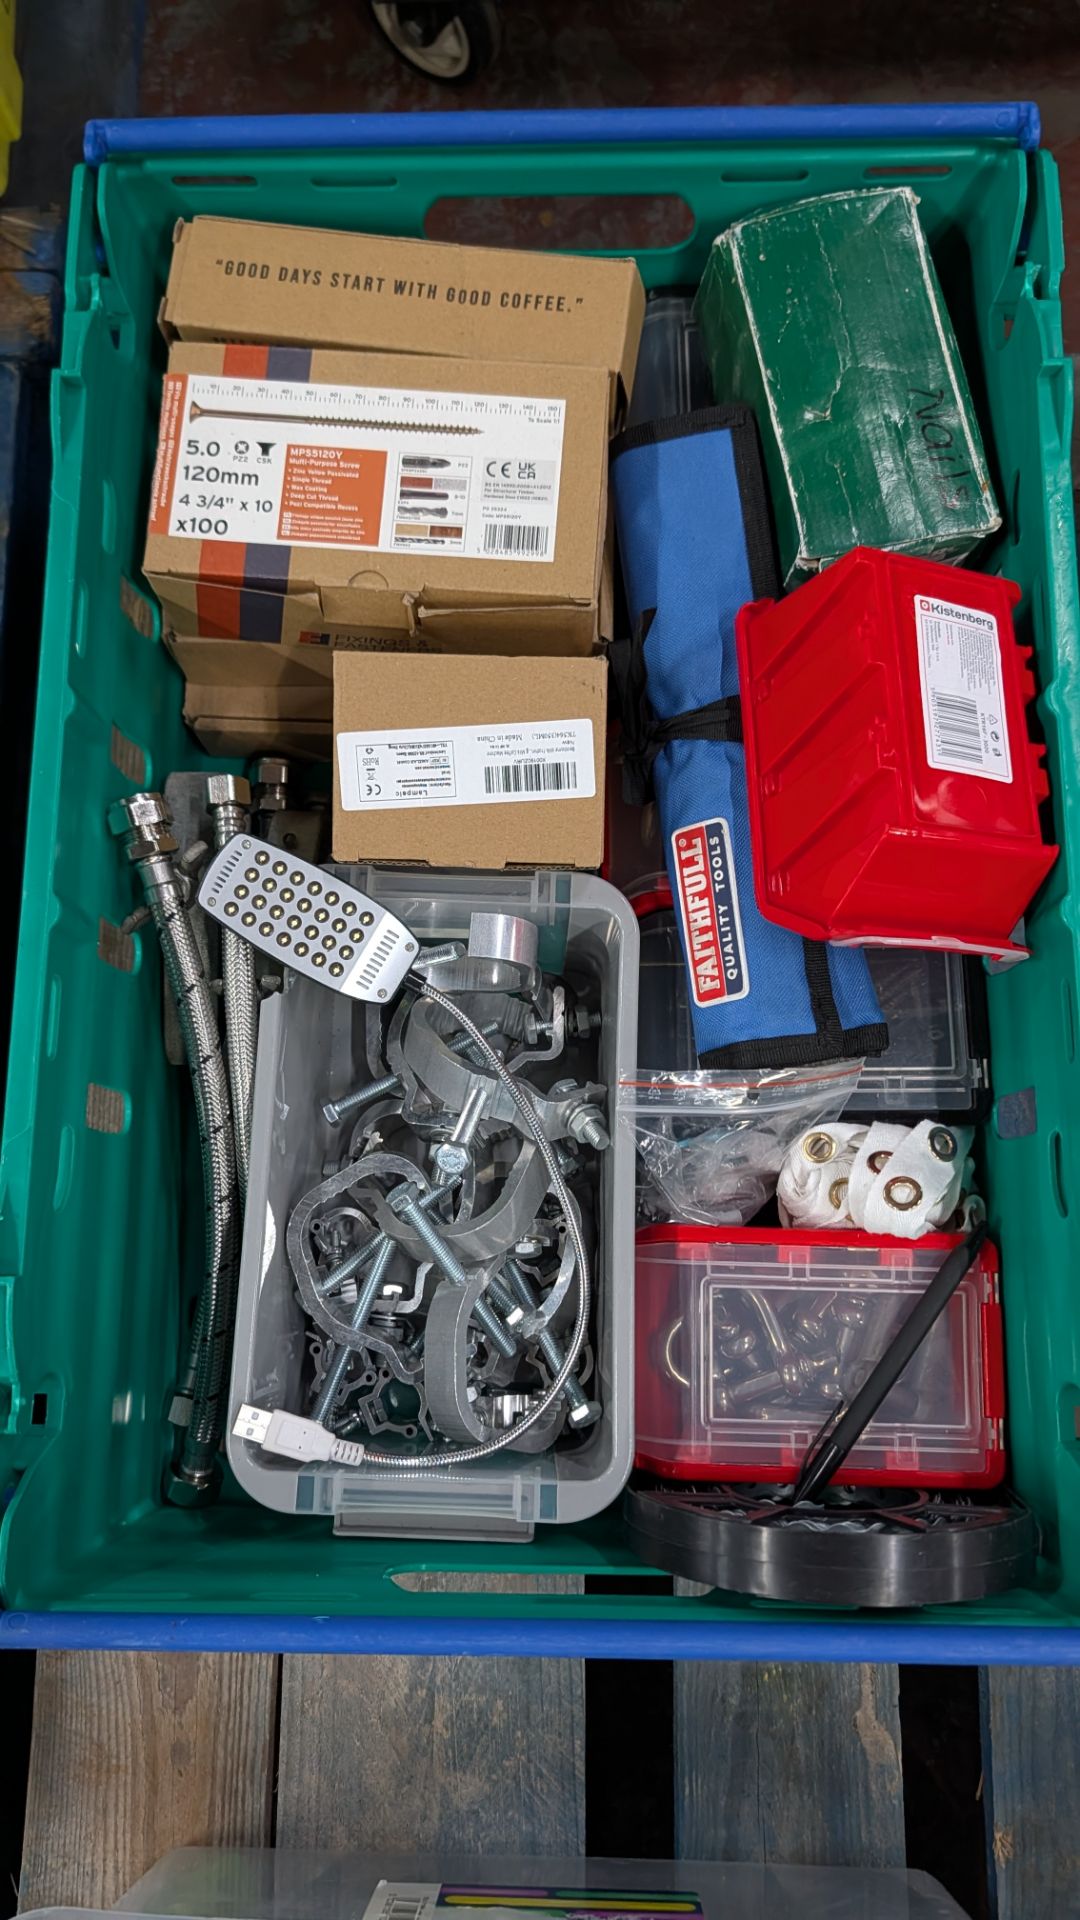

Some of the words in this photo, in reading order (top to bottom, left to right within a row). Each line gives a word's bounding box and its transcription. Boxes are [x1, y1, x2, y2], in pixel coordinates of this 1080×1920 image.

[278, 267, 322, 286] DAYS
[330, 272, 385, 293] START
[393, 279, 438, 300] WITH
[446, 287, 492, 307] GOOD
[186, 439, 221, 457] 5.0
[290, 447, 343, 459] MPS5120Y
[232, 455, 248, 463] PZ2
[288, 458, 337, 467] Multi-Purpose
[339, 461, 360, 469] Screw
[518, 462, 536, 471] UK
[183, 465, 259, 486] 120mm
[517, 471, 536, 480] CA
[179, 494, 190, 506] 4
[196, 494, 234, 510] 3/4"
[239, 501, 248, 512] x
[255, 499, 273, 513] 10
[176, 517, 228, 535] x100
[931, 603, 994, 631] Kistenberg
[504, 733, 522, 741] Made
[709, 835, 726, 893] TOOLS
[680, 837, 722, 994] FAITHFULL
[717, 904, 738, 980] QUALITY
